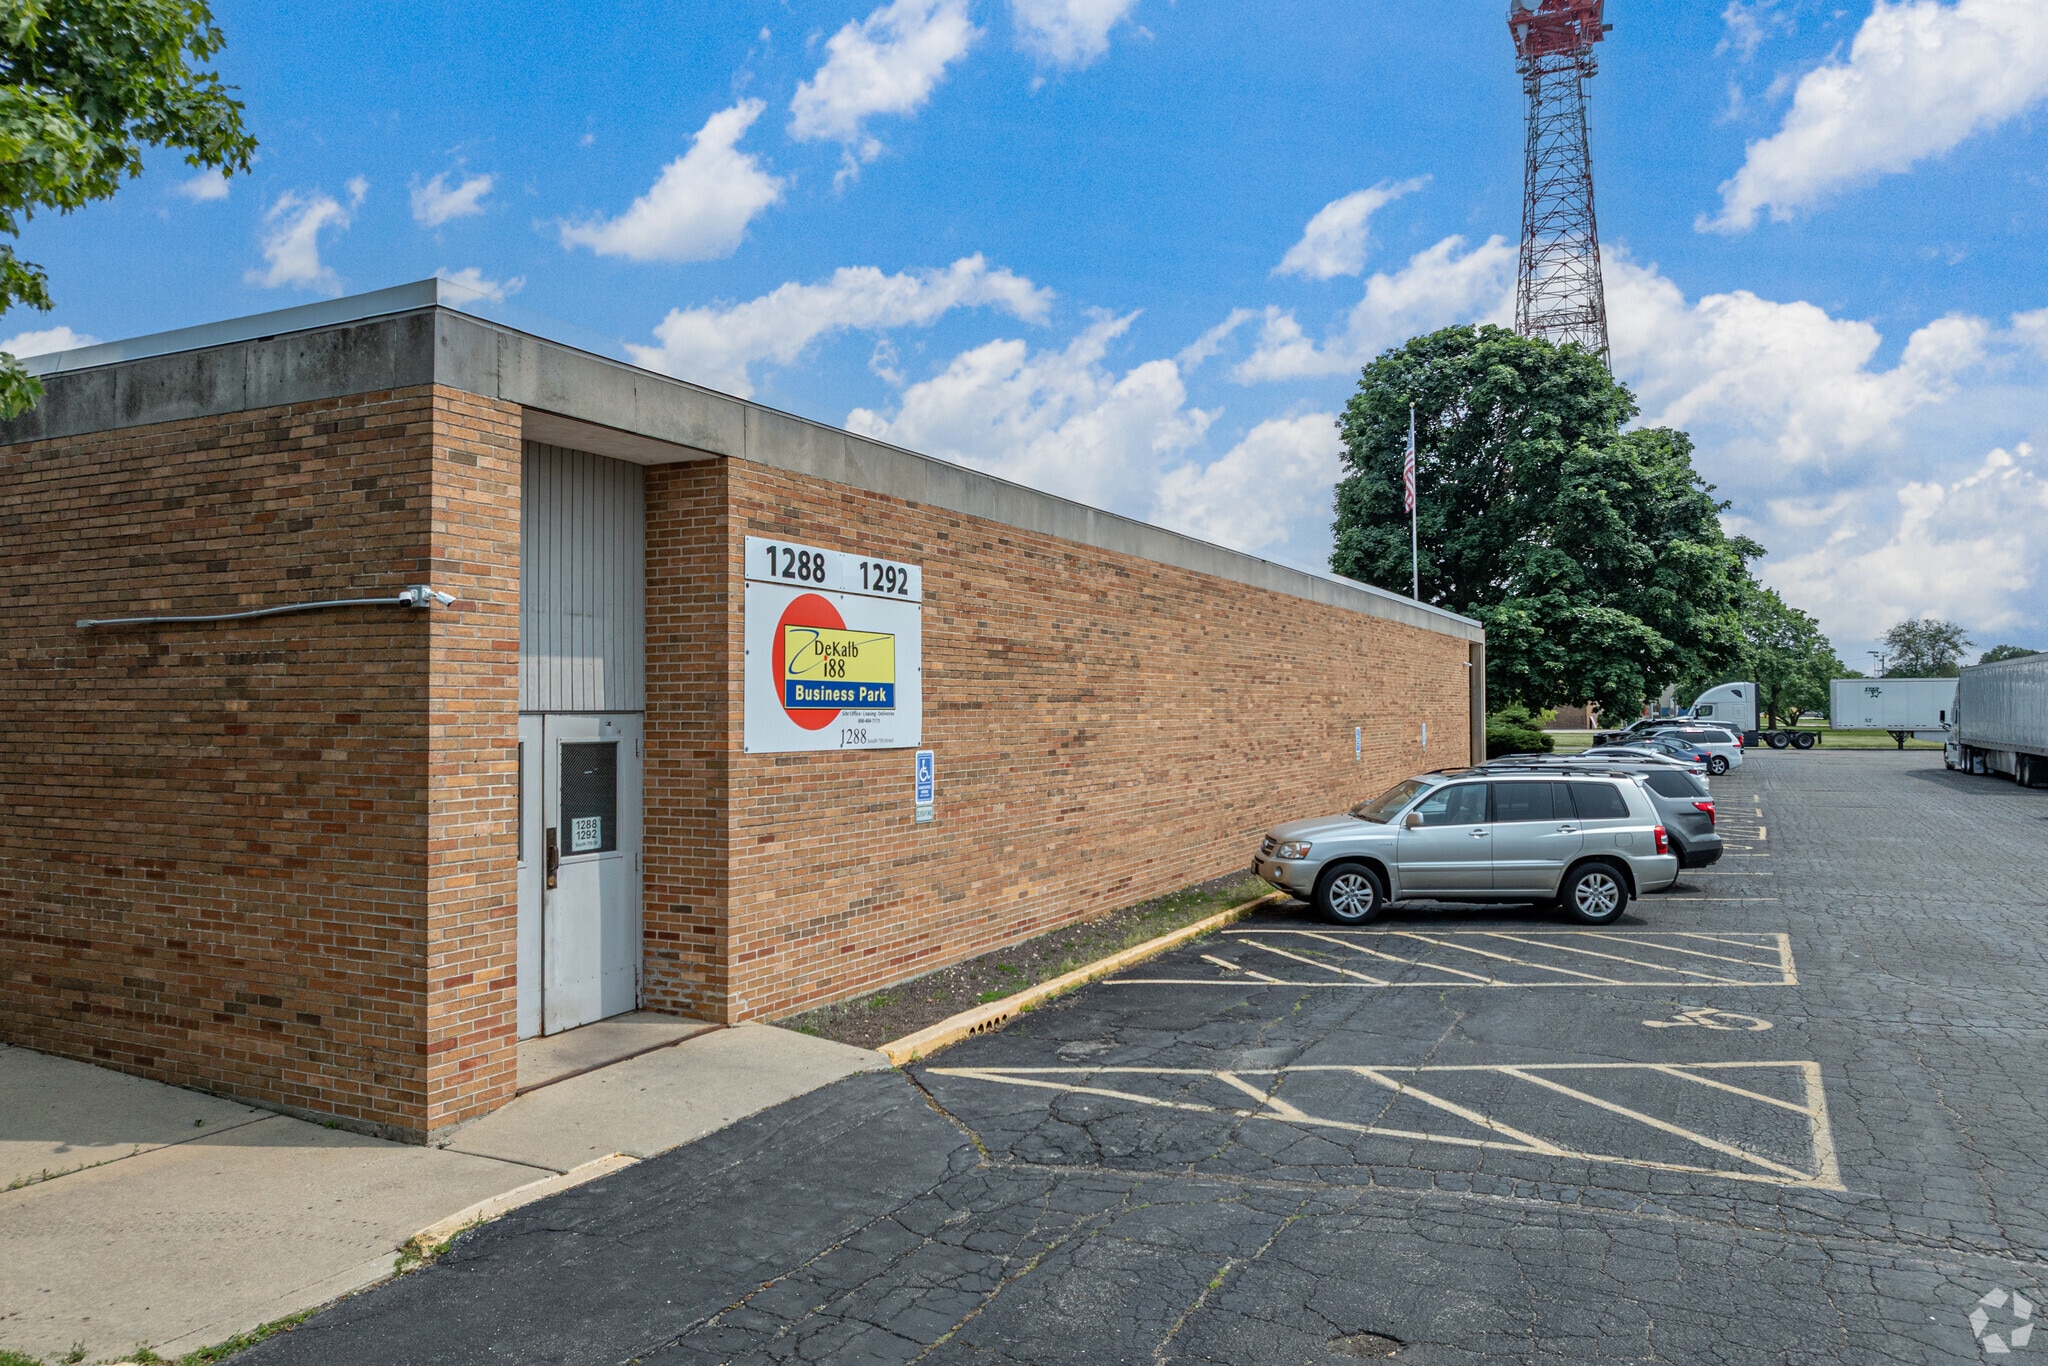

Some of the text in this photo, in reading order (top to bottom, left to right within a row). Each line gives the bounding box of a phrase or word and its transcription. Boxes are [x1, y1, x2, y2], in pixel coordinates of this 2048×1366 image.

[765, 545, 826, 583] 1288
[859, 561, 908, 596] 1292
[814, 640, 859, 658] DeKalb
[795, 684, 887, 702] Business Park
[841, 728, 867, 745] 1288
[576, 818, 597, 830] 1288
[576, 829, 597, 840] 1292
